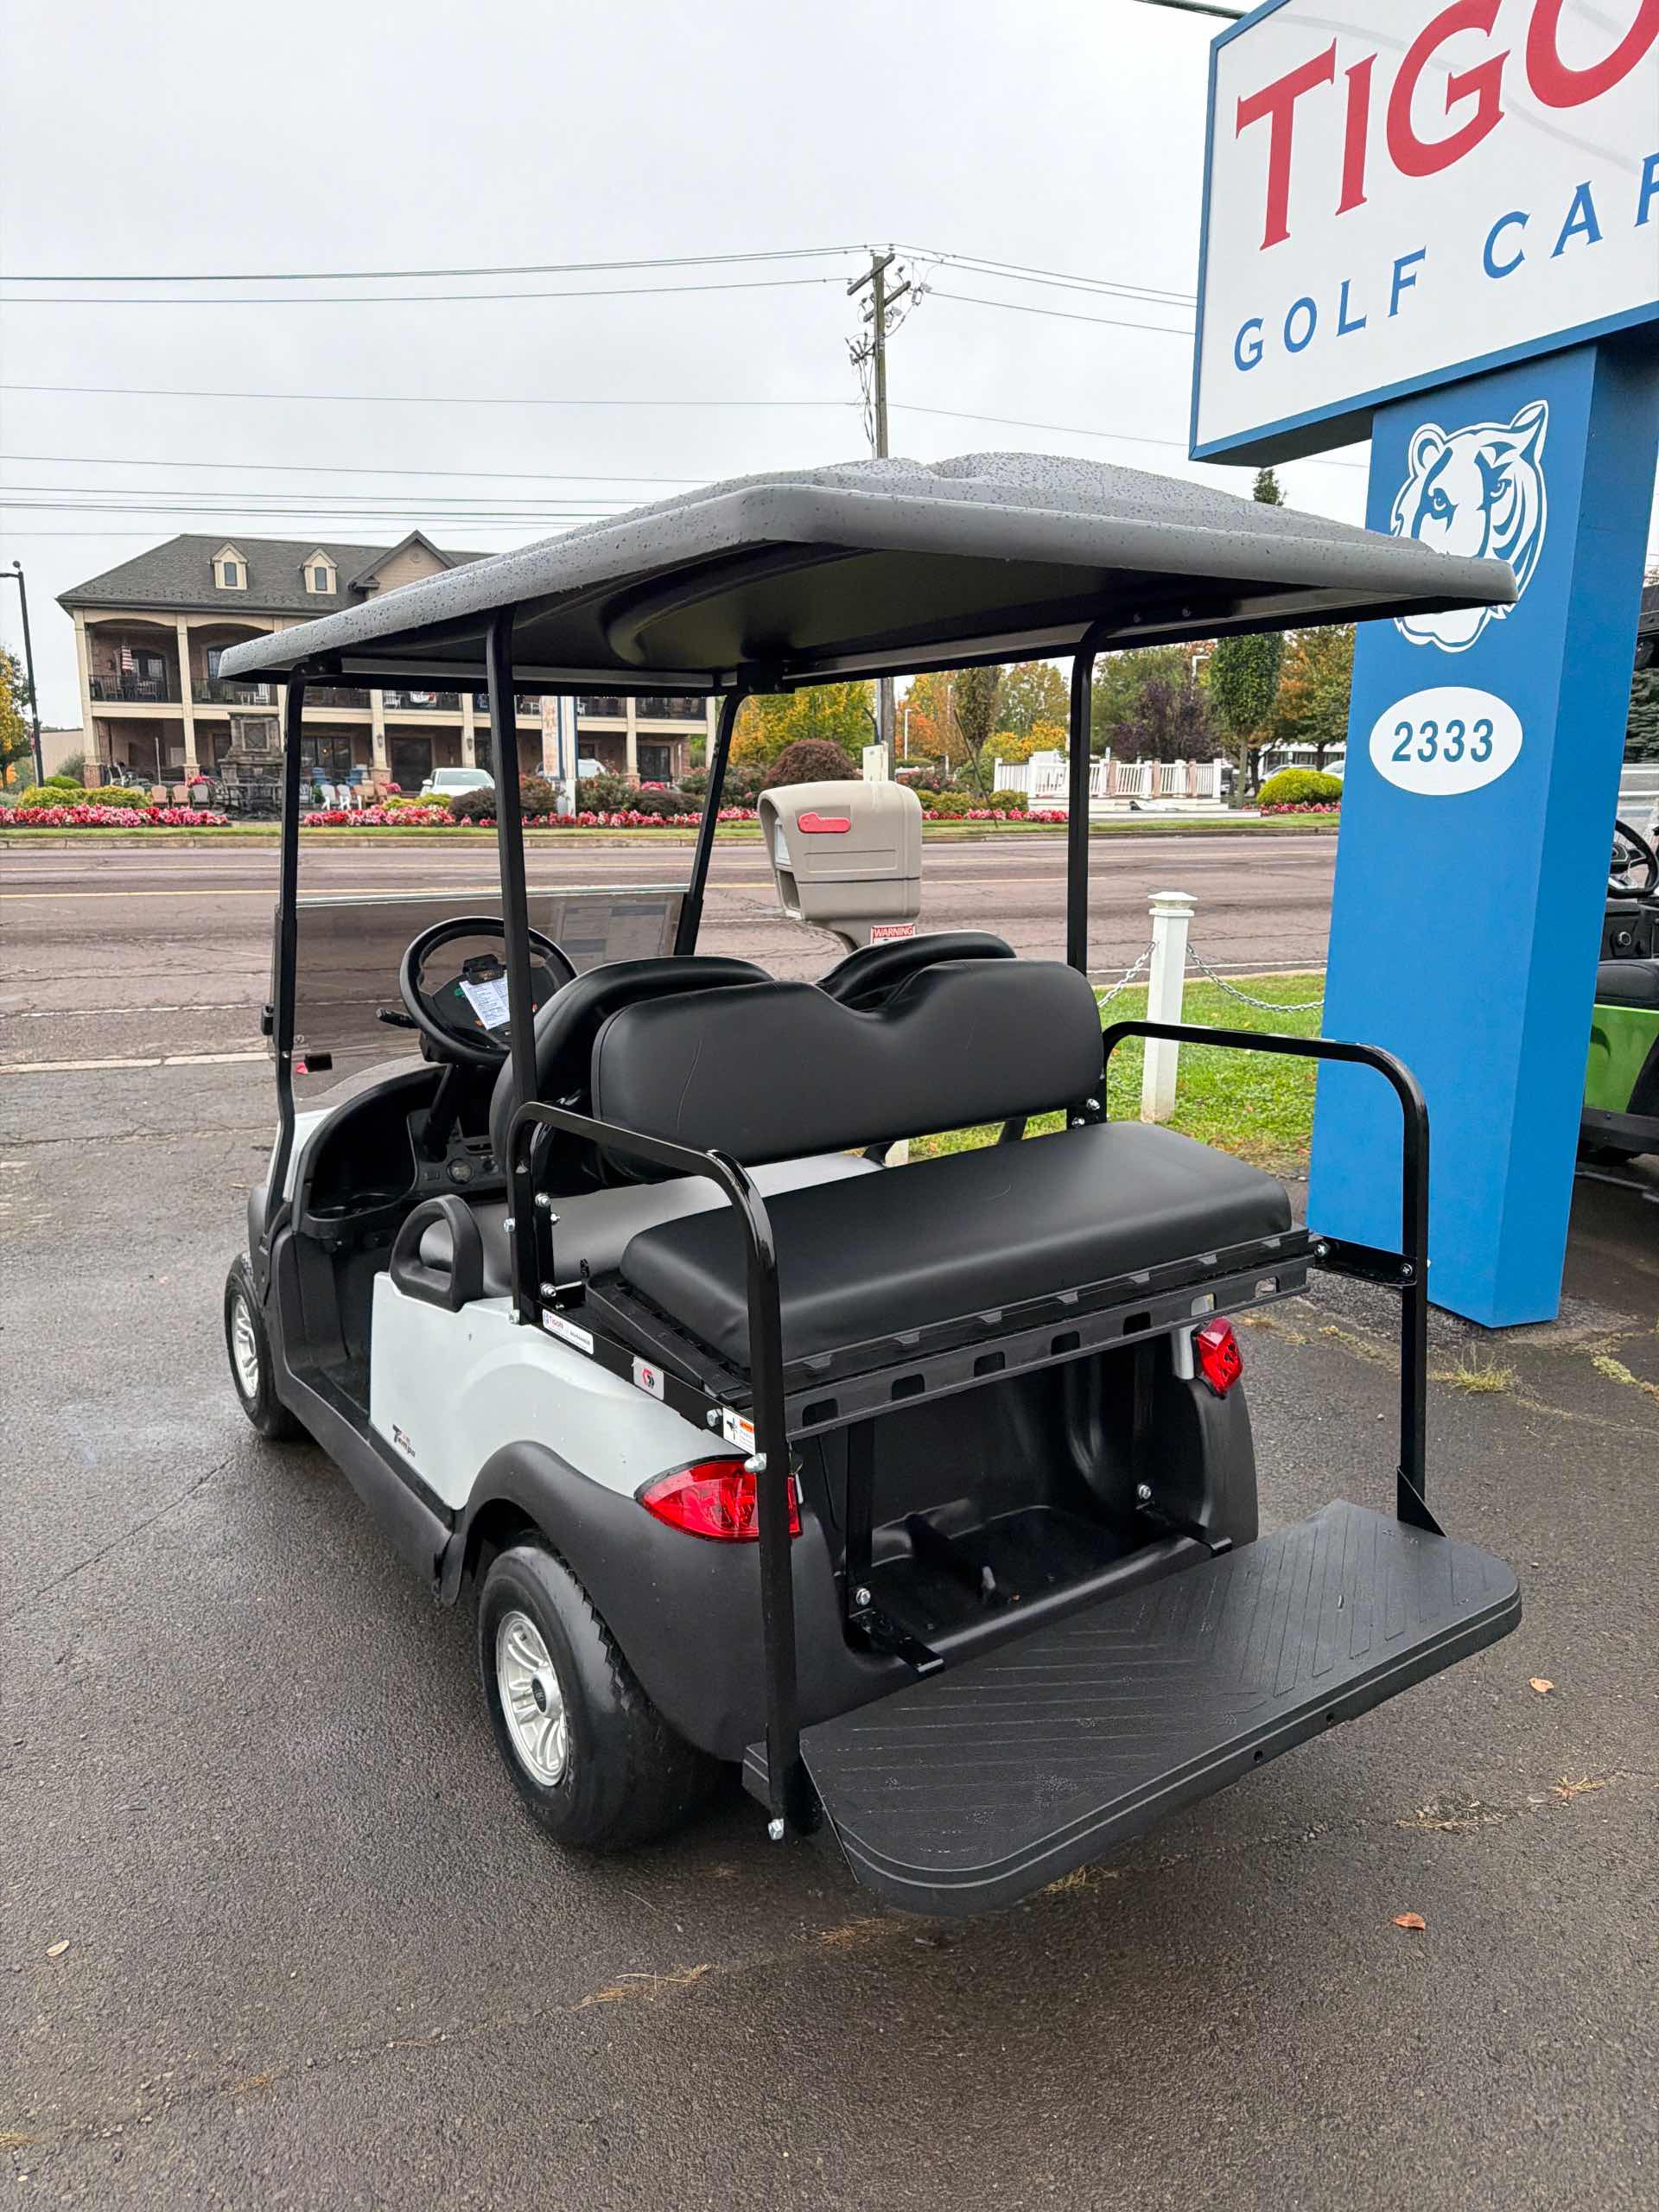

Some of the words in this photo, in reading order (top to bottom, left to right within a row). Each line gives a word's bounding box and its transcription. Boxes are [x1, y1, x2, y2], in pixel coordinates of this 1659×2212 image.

[1235, 0, 1659, 251] TIGO
[1234, 245, 1427, 372] GOLF
[1391, 718, 1493, 763] 2333
[874, 927, 912, 937] WARNING
